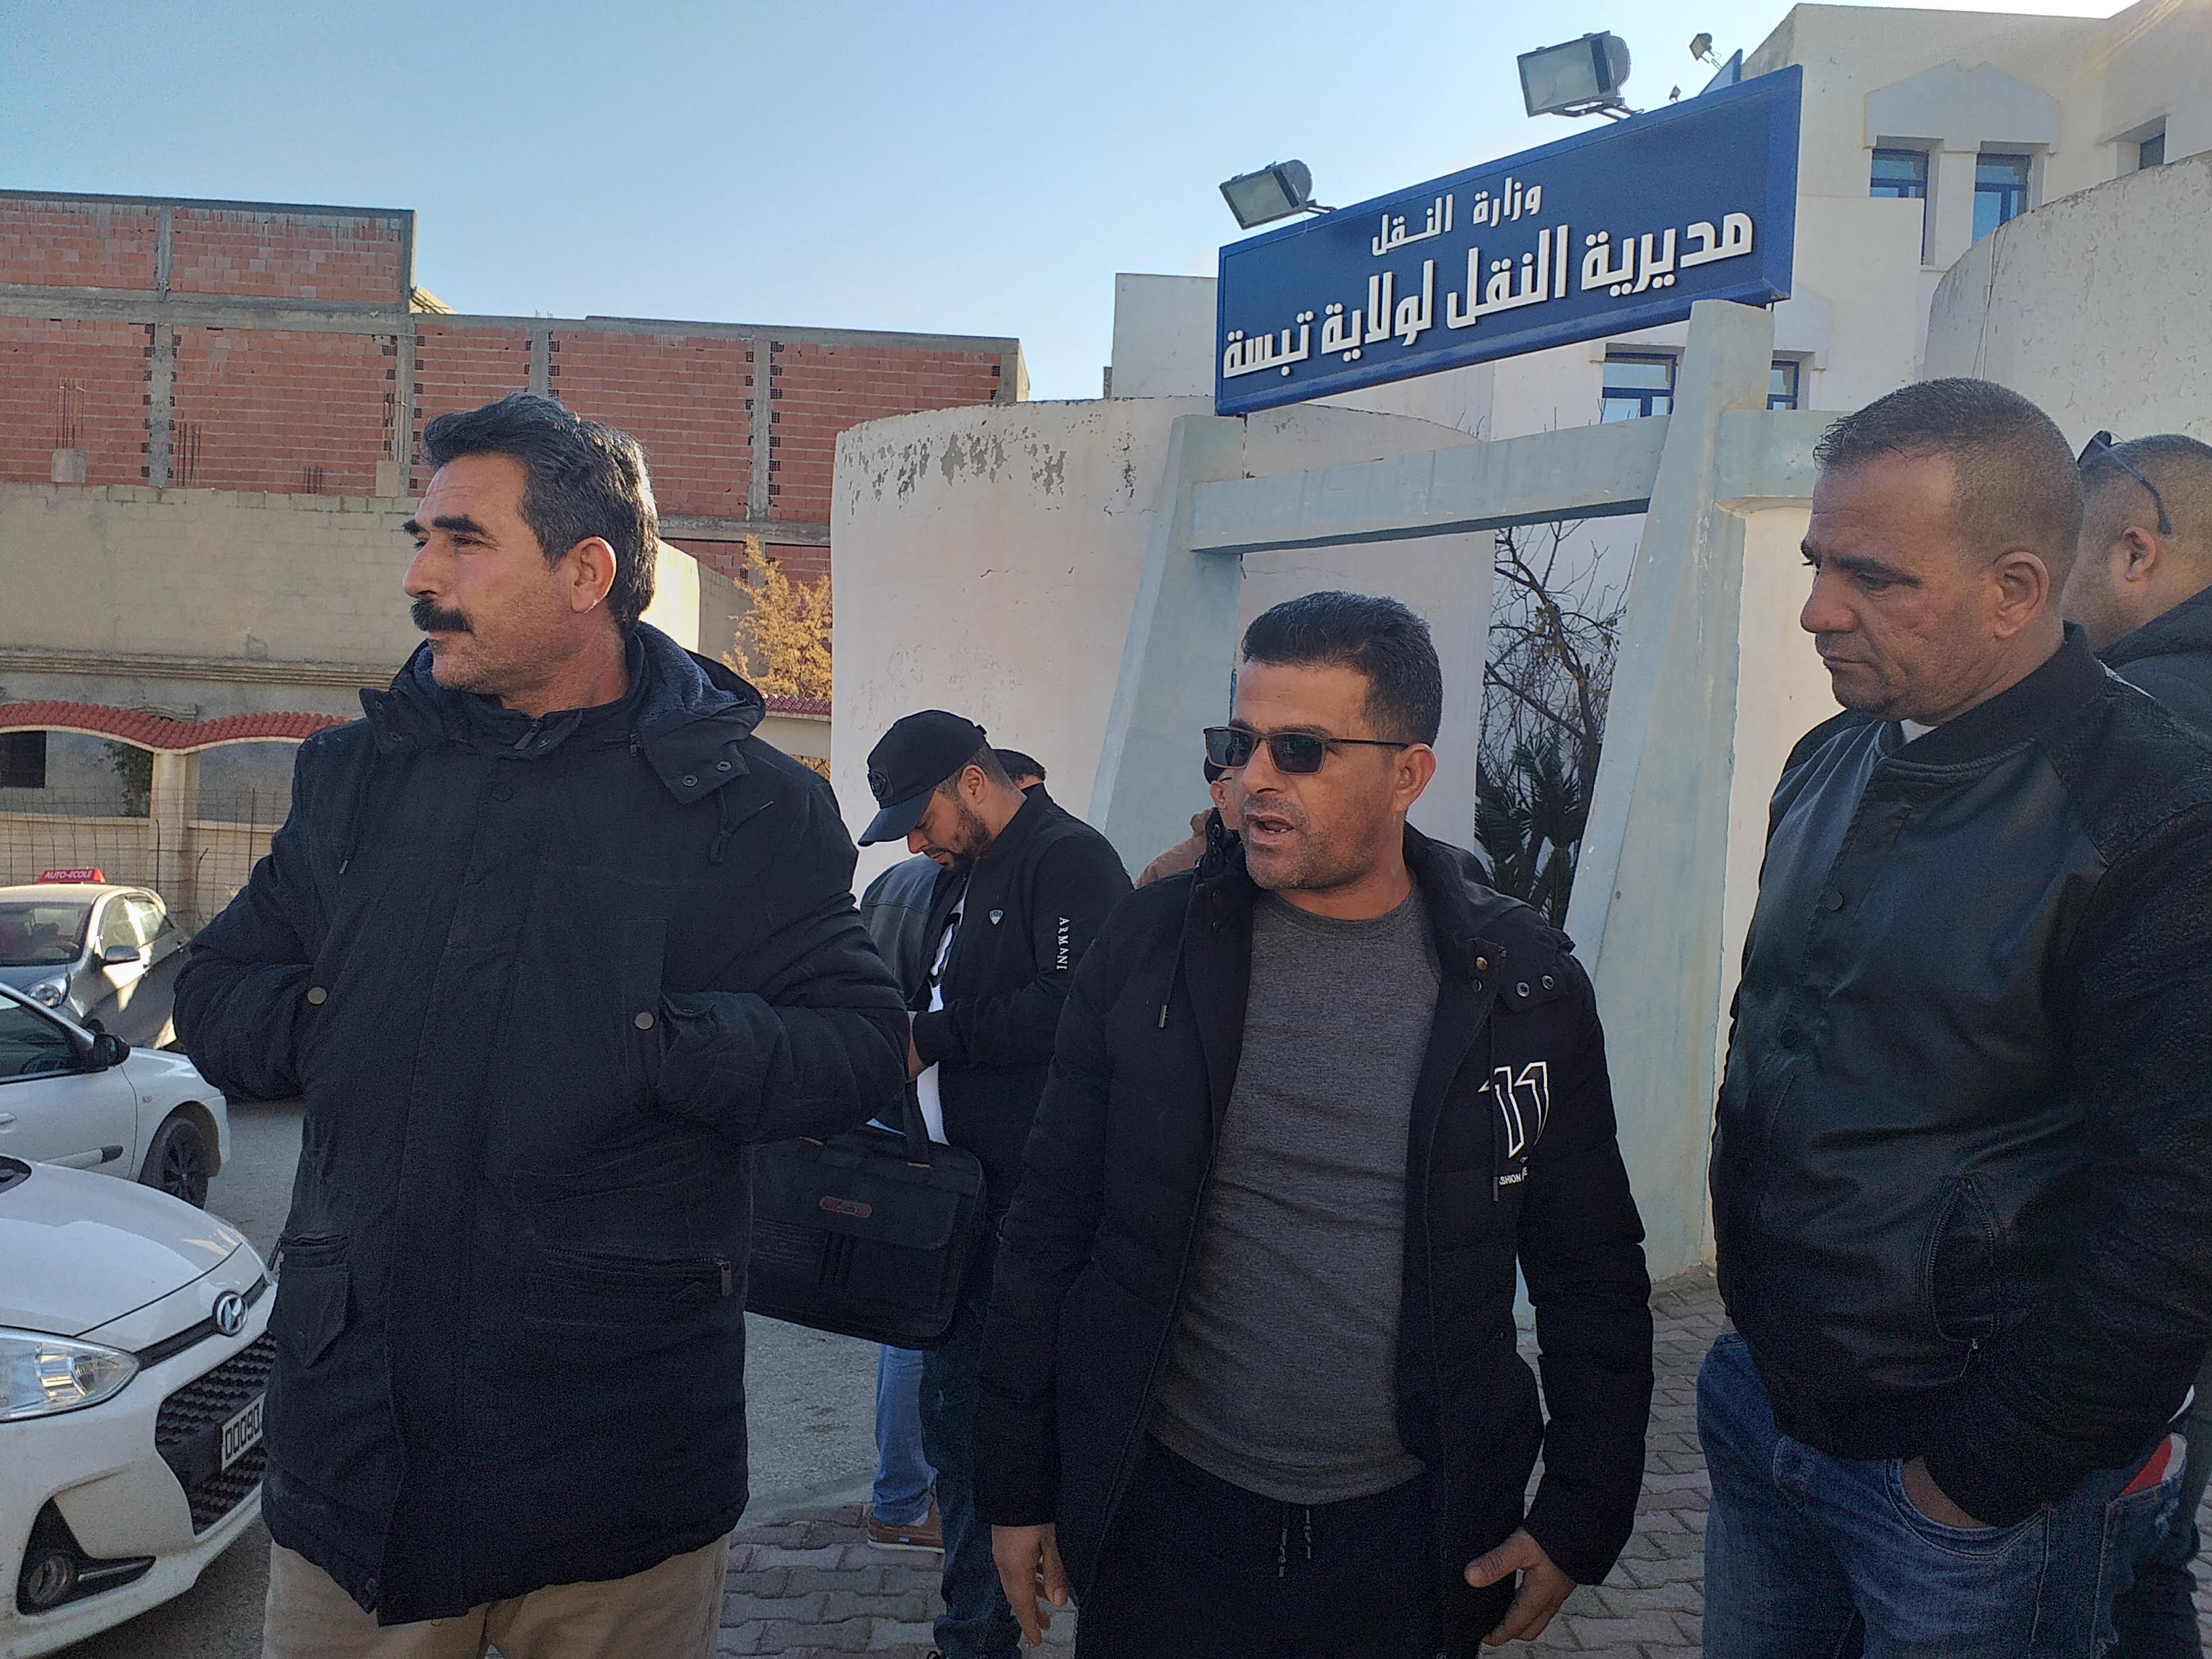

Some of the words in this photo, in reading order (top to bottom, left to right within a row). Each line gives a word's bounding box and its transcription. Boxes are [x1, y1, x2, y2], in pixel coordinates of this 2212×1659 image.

[1372, 193, 1454, 257] النقل
[1472, 176, 1542, 228] وزارة
[1446, 224, 1569, 329] النقل
[1580, 211, 1753, 298] مديرية
[1320, 259, 1434, 363] لولاية
[1223, 310, 1310, 379] تبسة
[44, 870, 93, 879] AUTO-ECOLE
[1057, 917, 1071, 970] ARMANI
